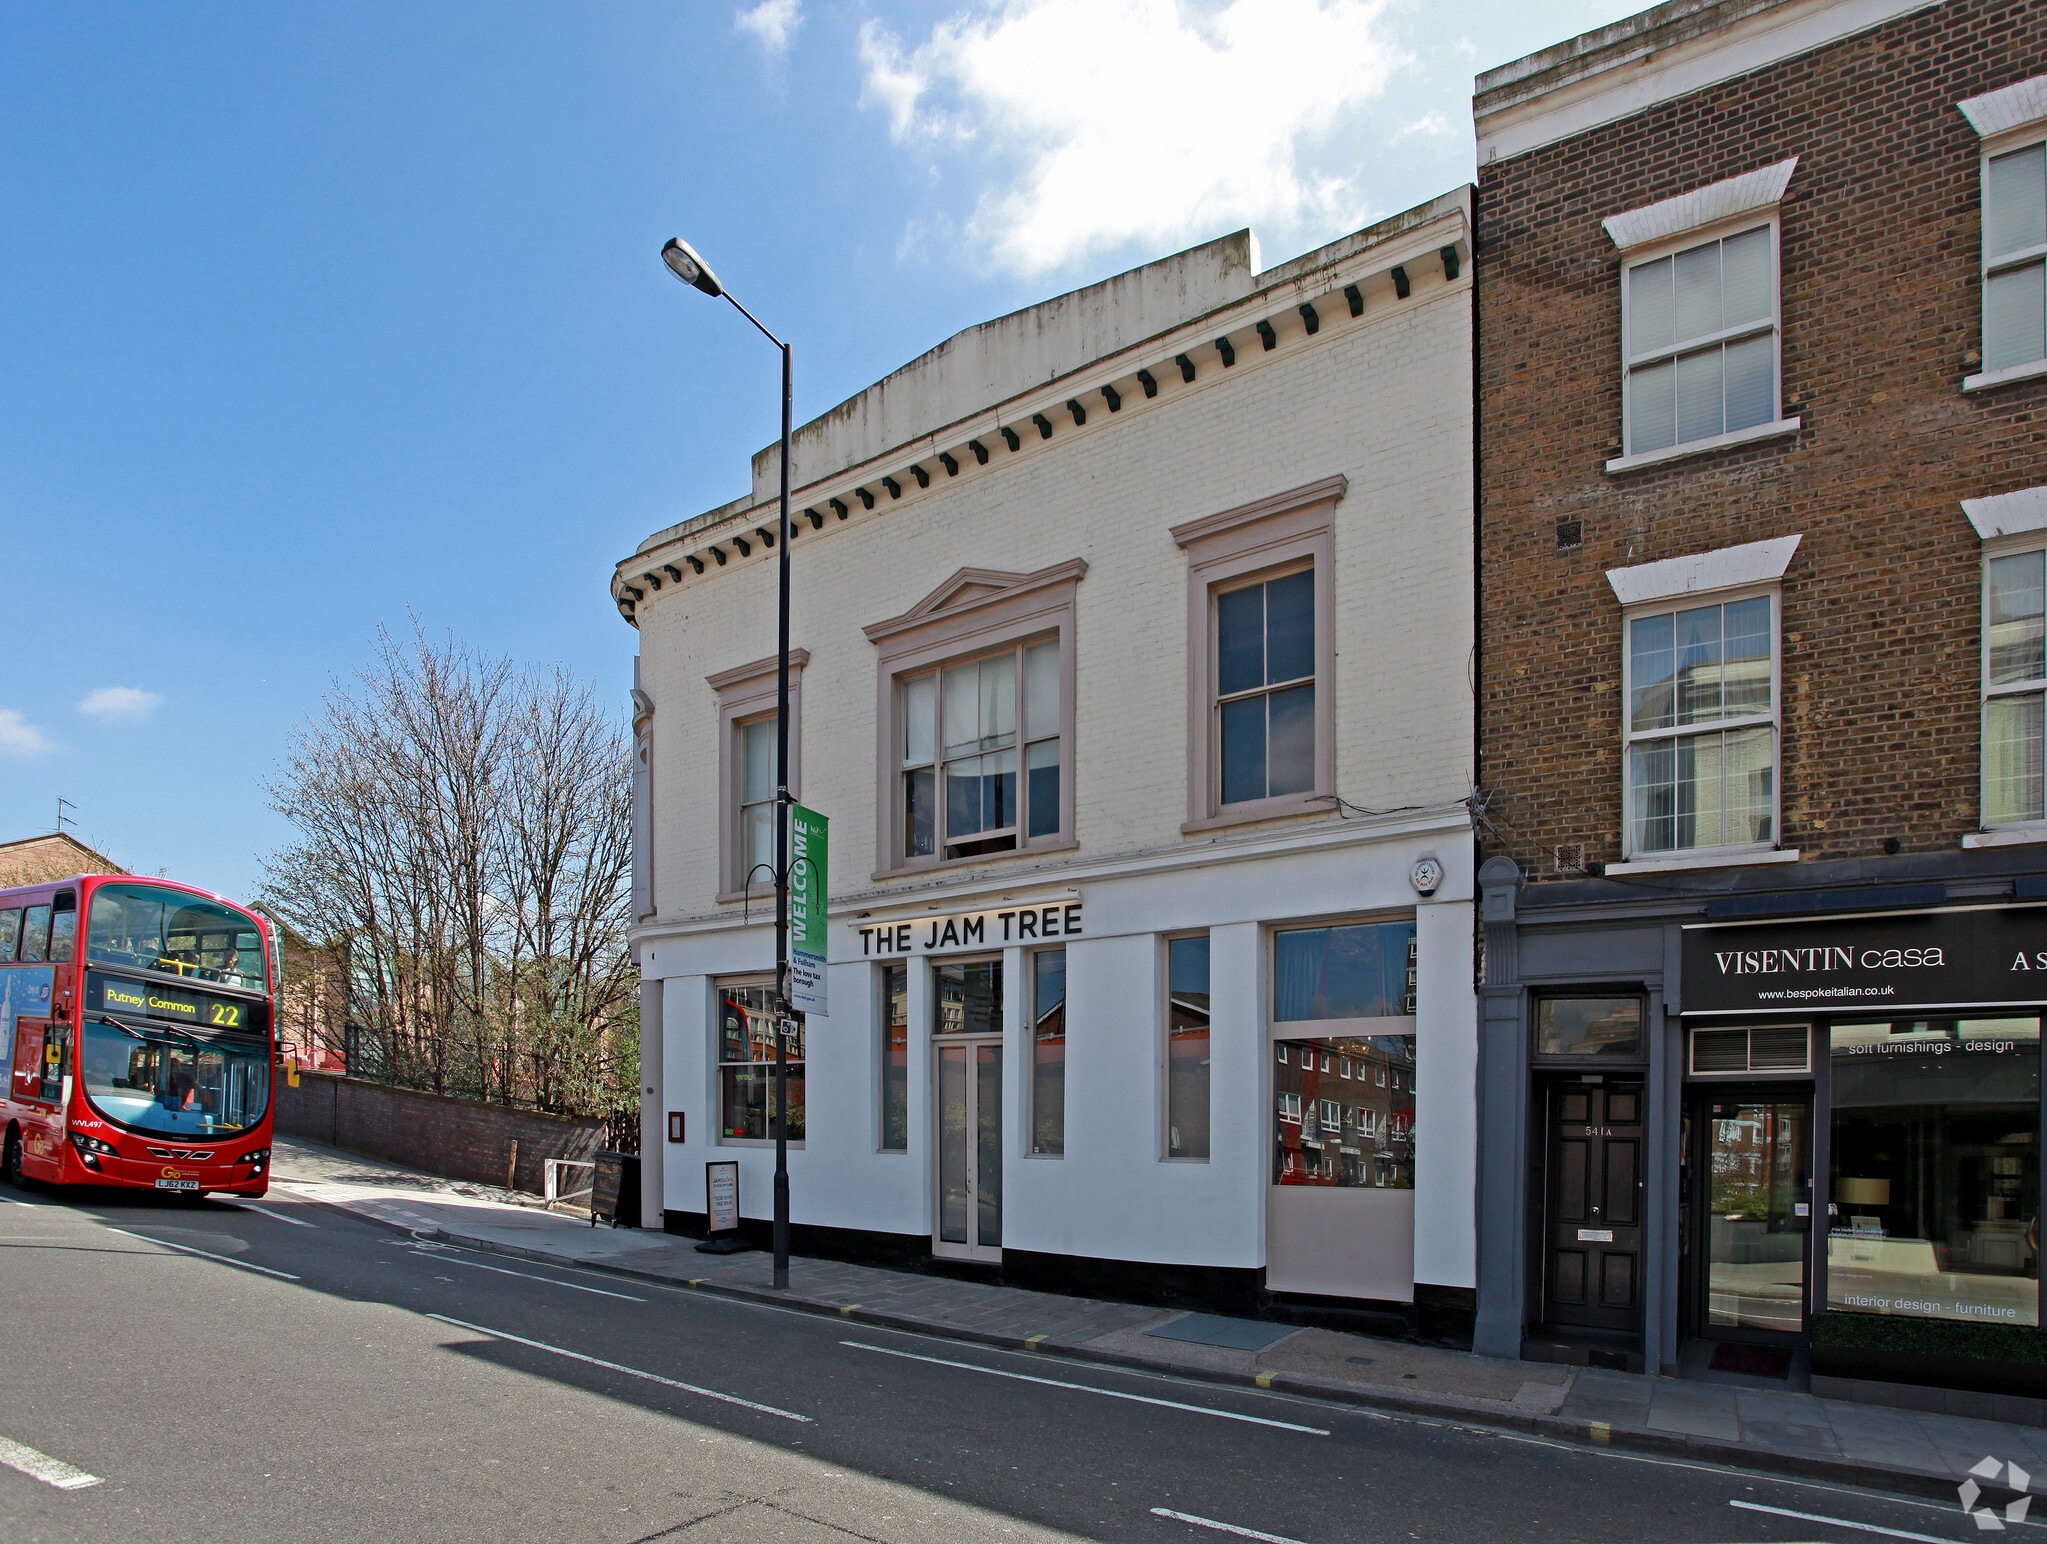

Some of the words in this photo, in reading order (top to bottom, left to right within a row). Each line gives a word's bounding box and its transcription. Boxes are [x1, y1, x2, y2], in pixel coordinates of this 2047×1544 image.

[793, 818, 807, 941] WELCOME
[858, 924, 911, 955] THE
[924, 915, 984, 949] JAM
[998, 903, 1083, 941] TREE
[793, 948, 827, 963] Hammersmith
[798, 958, 816, 968] Fulham
[1714, 945, 1855, 975] VISENTIN
[1860, 946, 1946, 970] casa
[793, 967, 802, 976] The
[802, 969, 812, 978] low
[812, 972, 821, 980] tax
[793, 976, 814, 988] borough
[1758, 985, 1895, 1000] www.bespokeitalian.co.uk
[107, 989, 145, 1008] Putney
[148, 996, 196, 1014] Common
[211, 1003, 239, 1027] 22
[1848, 1043, 1873, 1055] soft
[1877, 1041, 1952, 1055] furnishings
[1965, 1039, 2014, 1053] design
[72, 1119, 103, 1128] WVL497
[1585, 1126, 1612, 1136] 541A
[161, 1165, 181, 1179] Go
[158, 1180, 180, 1188] LJ62
[180, 1181, 196, 1189] KXZ
[1844, 1293, 1891, 1308] interior
[1894, 1298, 1941, 1314] design
[1954, 1302, 2016, 1318] furniture
